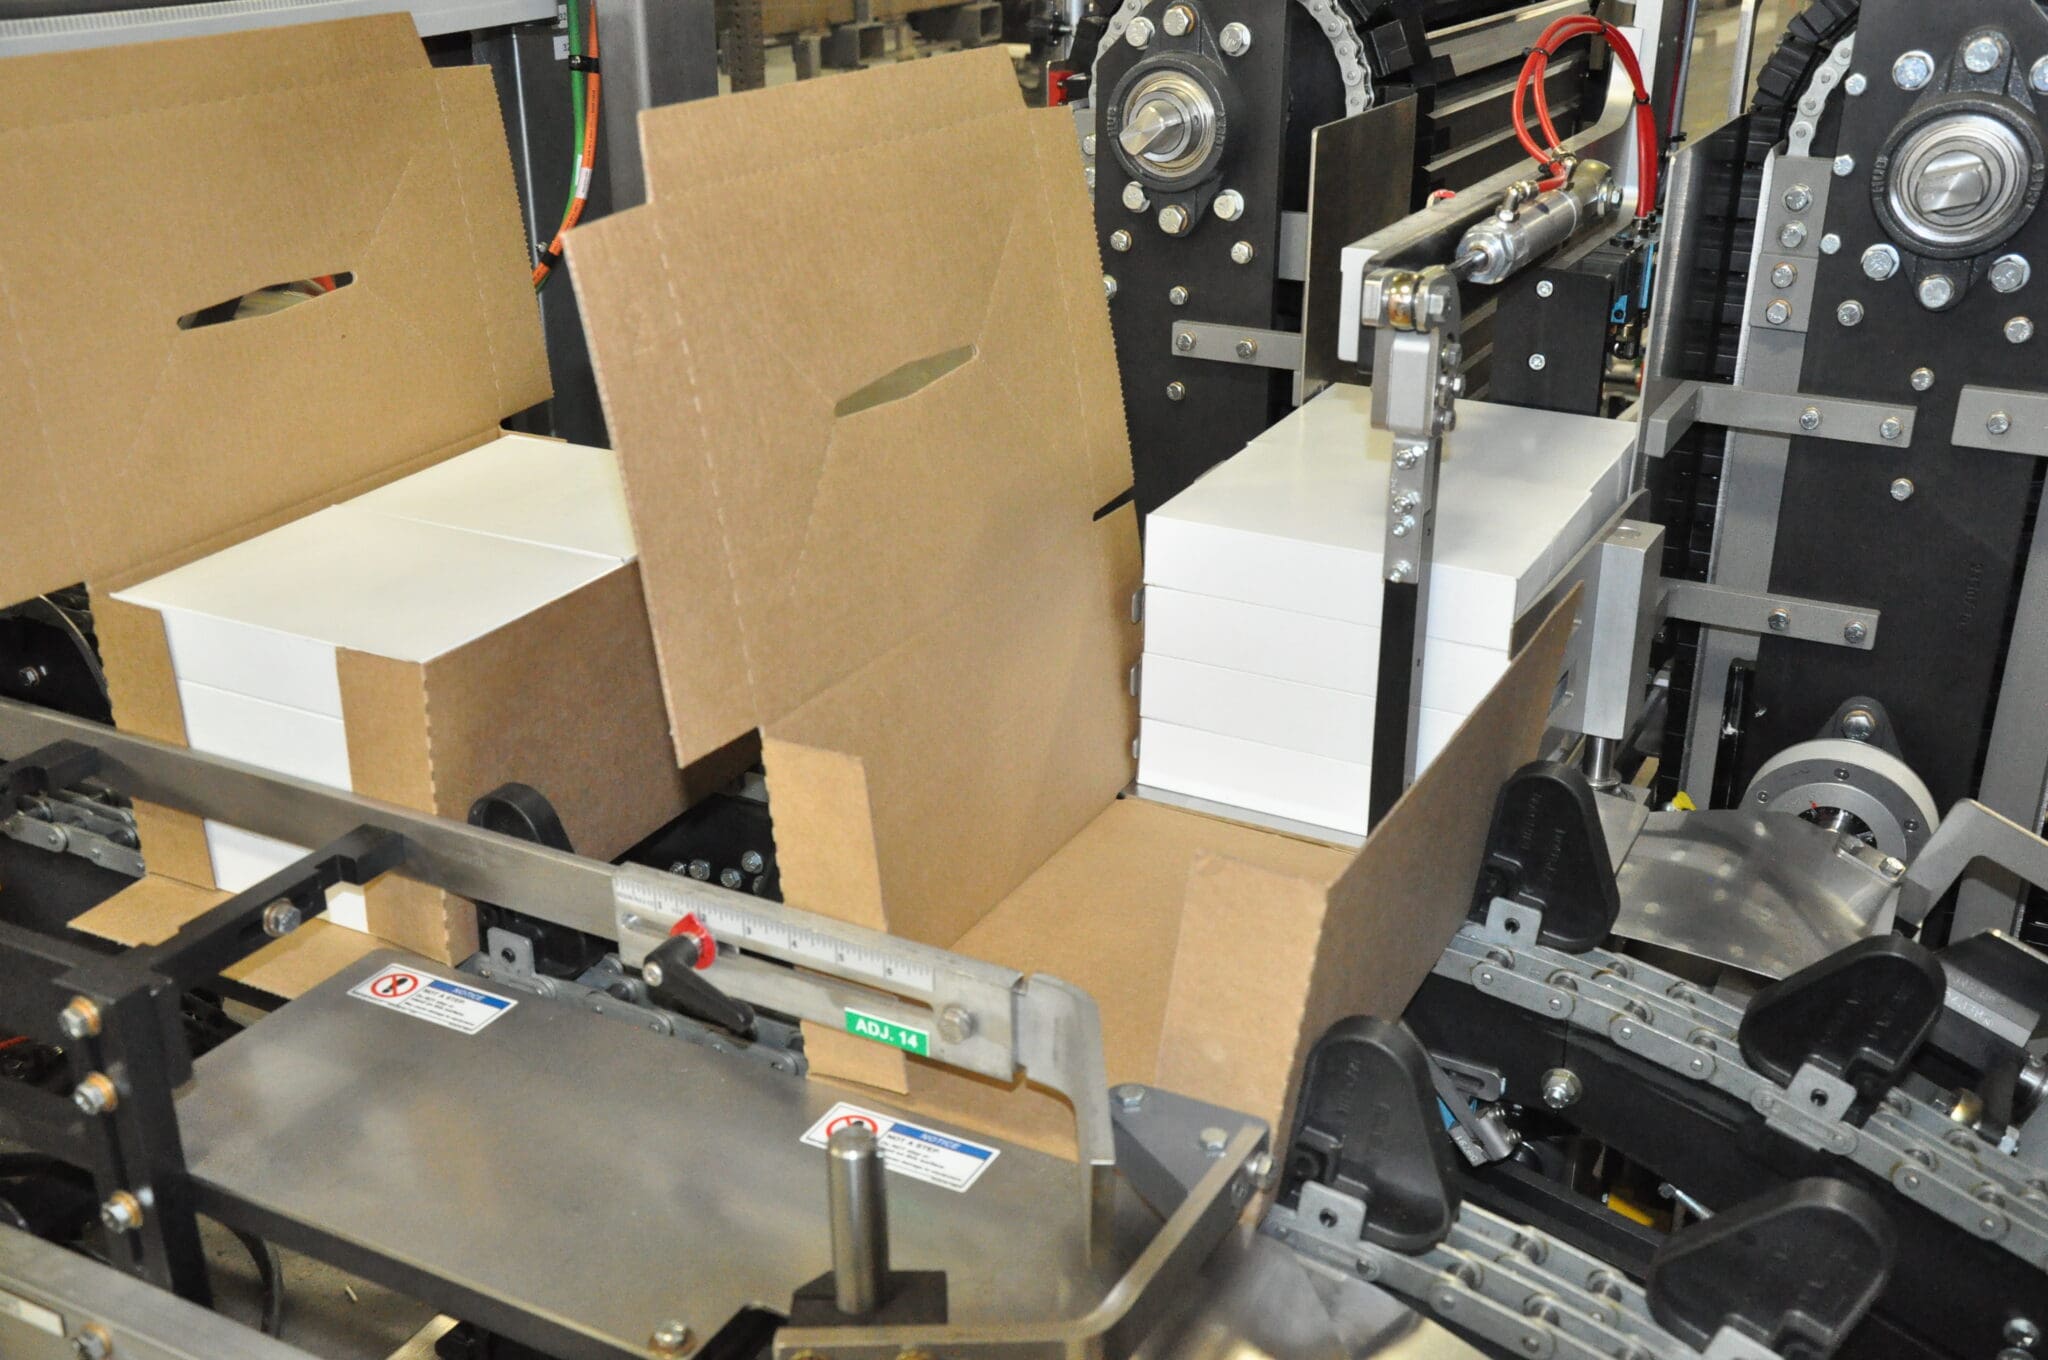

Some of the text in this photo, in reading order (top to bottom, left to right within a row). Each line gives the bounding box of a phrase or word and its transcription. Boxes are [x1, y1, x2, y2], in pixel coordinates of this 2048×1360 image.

[452, 987, 486, 1001] NOTICE
[855, 1018, 919, 1049] ADJ. 14
[920, 1133, 962, 1150] NOTICE
